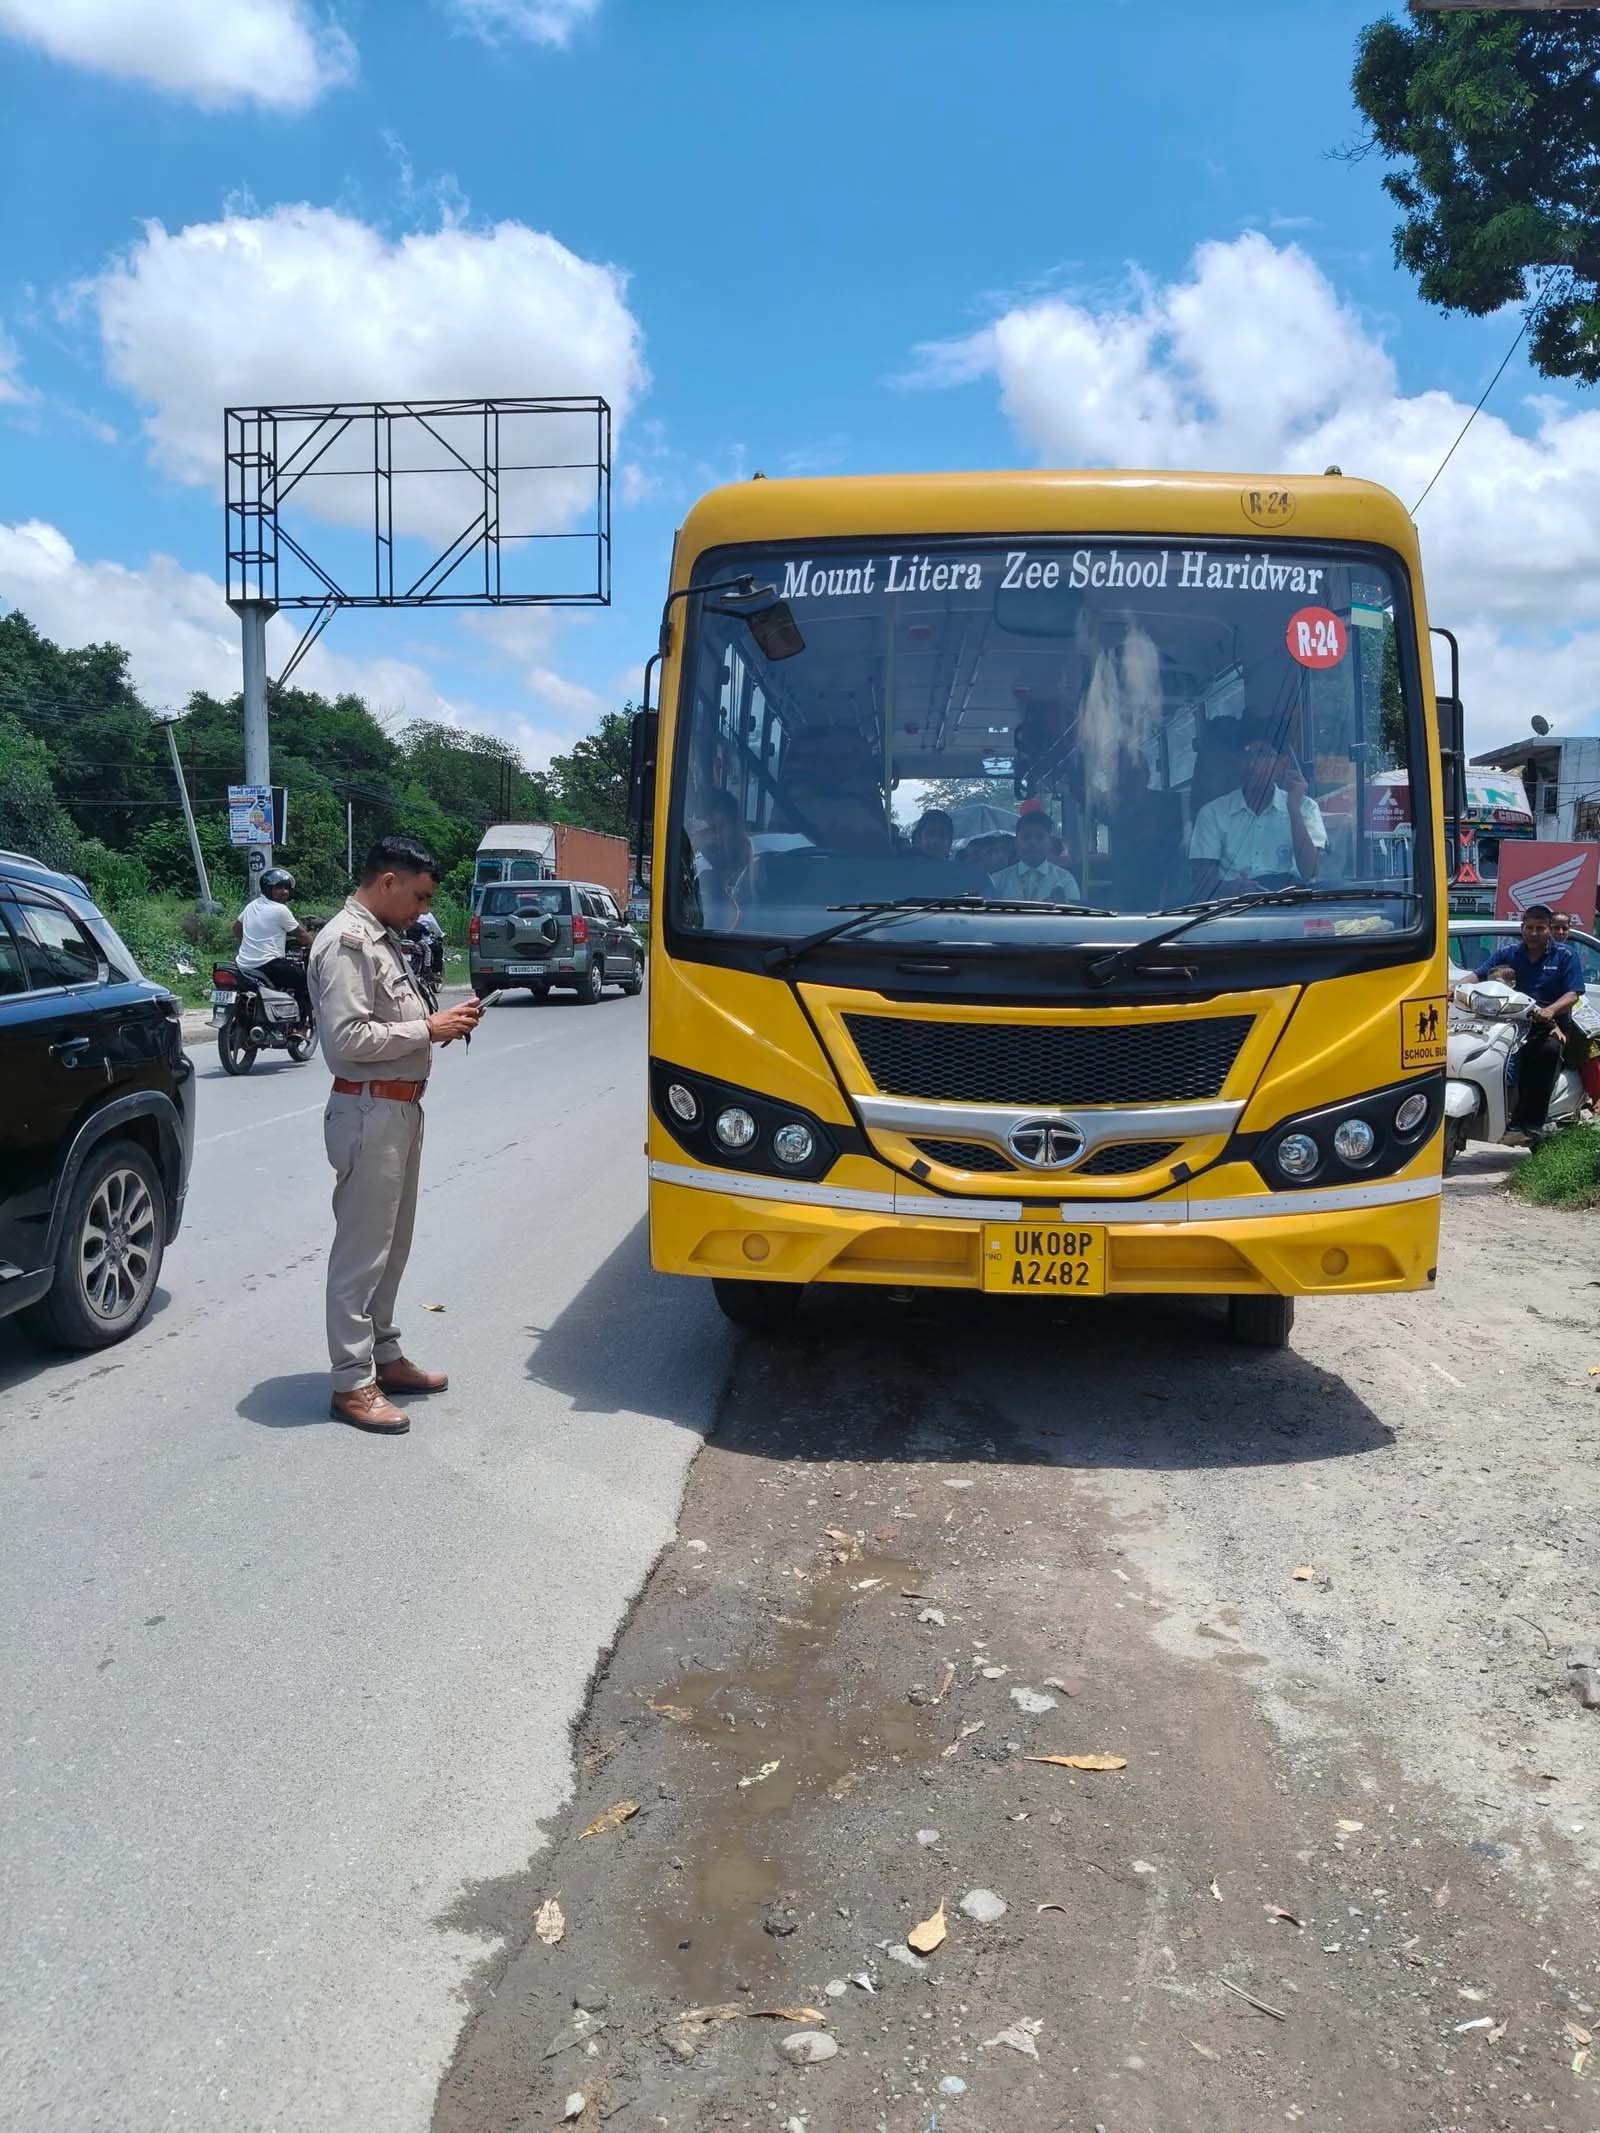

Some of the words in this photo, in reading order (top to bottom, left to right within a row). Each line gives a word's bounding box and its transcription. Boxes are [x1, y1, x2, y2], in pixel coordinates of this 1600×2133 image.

[780, 559, 875, 598] Mount
[884, 555, 982, 592] Litera
[1001, 551, 1059, 589] Zee
[1069, 550, 1168, 589] School
[1178, 551, 1323, 594] Haridwar
[1297, 620, 1338, 657] R-24
[1404, 1048, 1434, 1060] SCHOOL
[1015, 1230, 1093, 1257] UK08P
[1011, 1260, 1090, 1286] A2482
